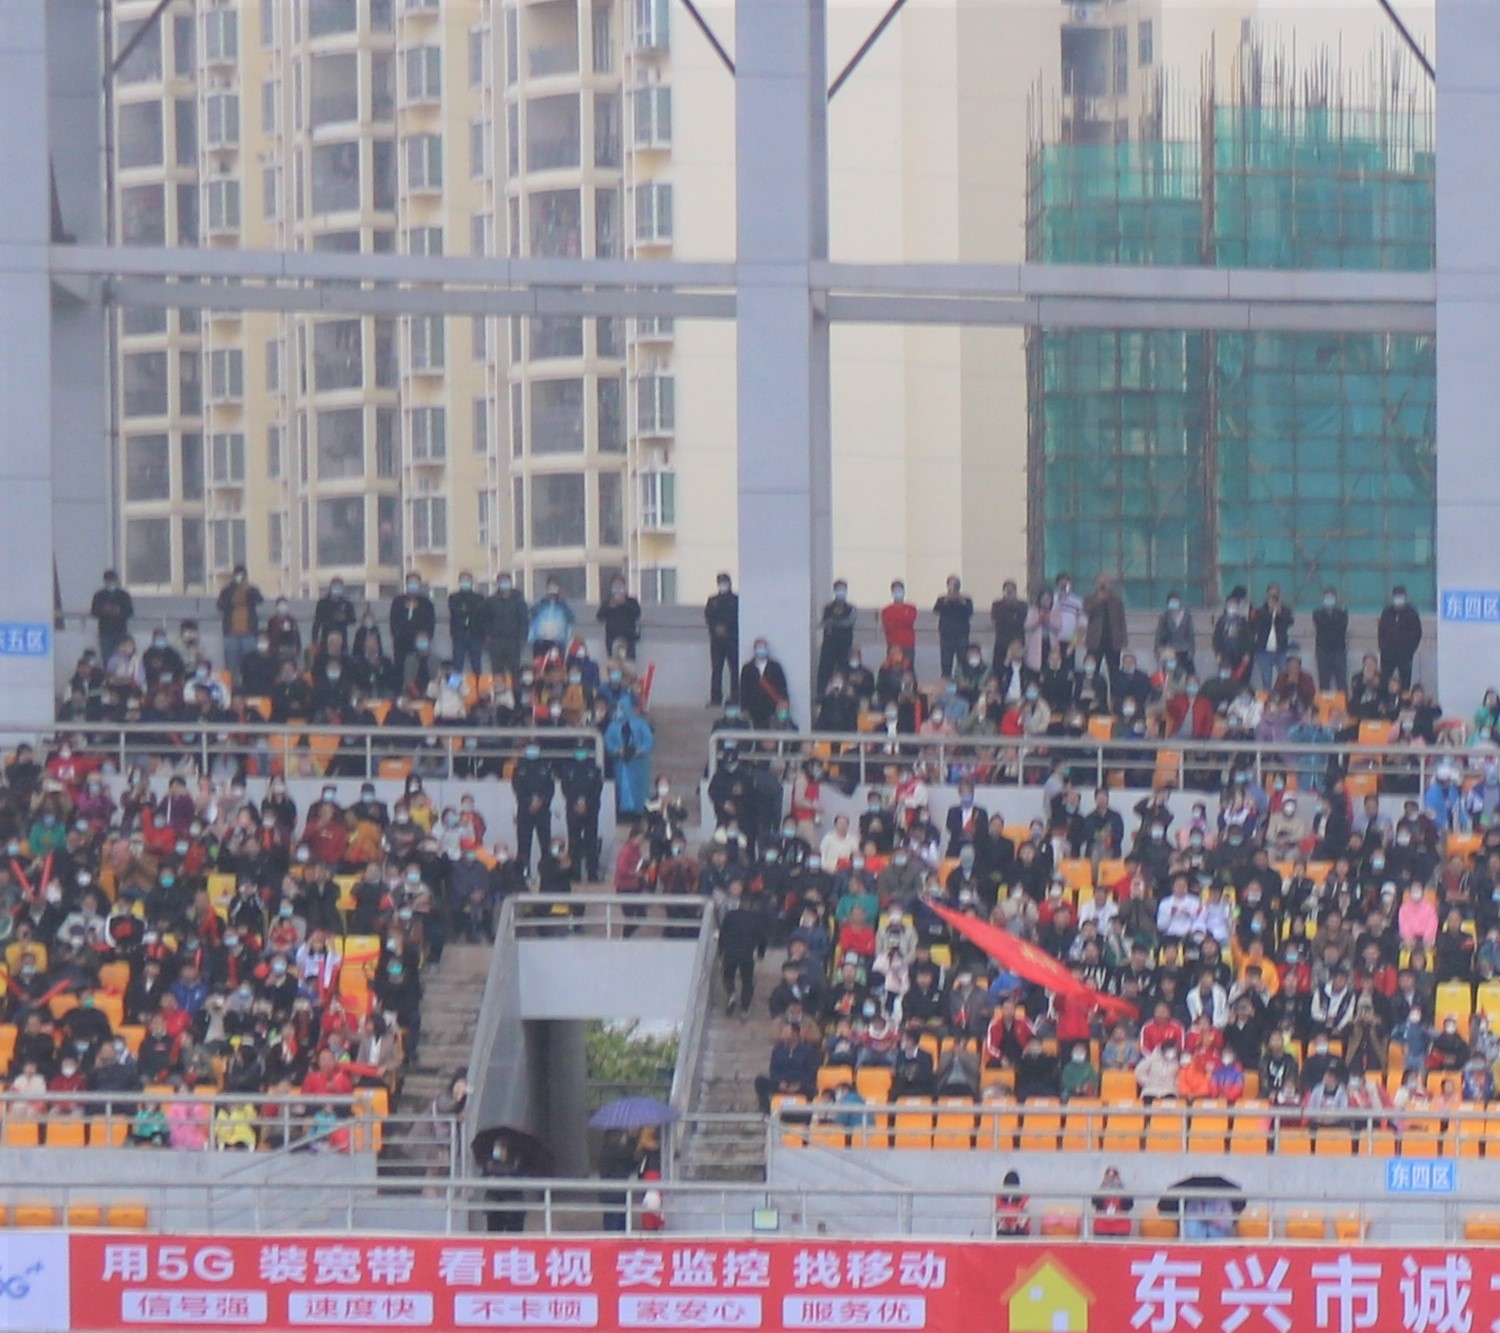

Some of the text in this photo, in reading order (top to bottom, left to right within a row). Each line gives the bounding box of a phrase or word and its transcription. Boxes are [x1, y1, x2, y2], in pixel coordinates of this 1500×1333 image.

[1446, 596, 1498, 618] 东四区
[0, 626, 45, 650] 五区
[1391, 1160, 1453, 1186] 东四区
[103, 1245, 947, 1290] 用5G 装宽带 看电视 安监控 找移动
[137, 1296, 912, 1323] 信号强 速度快 不卡顿 家安心 服务优
